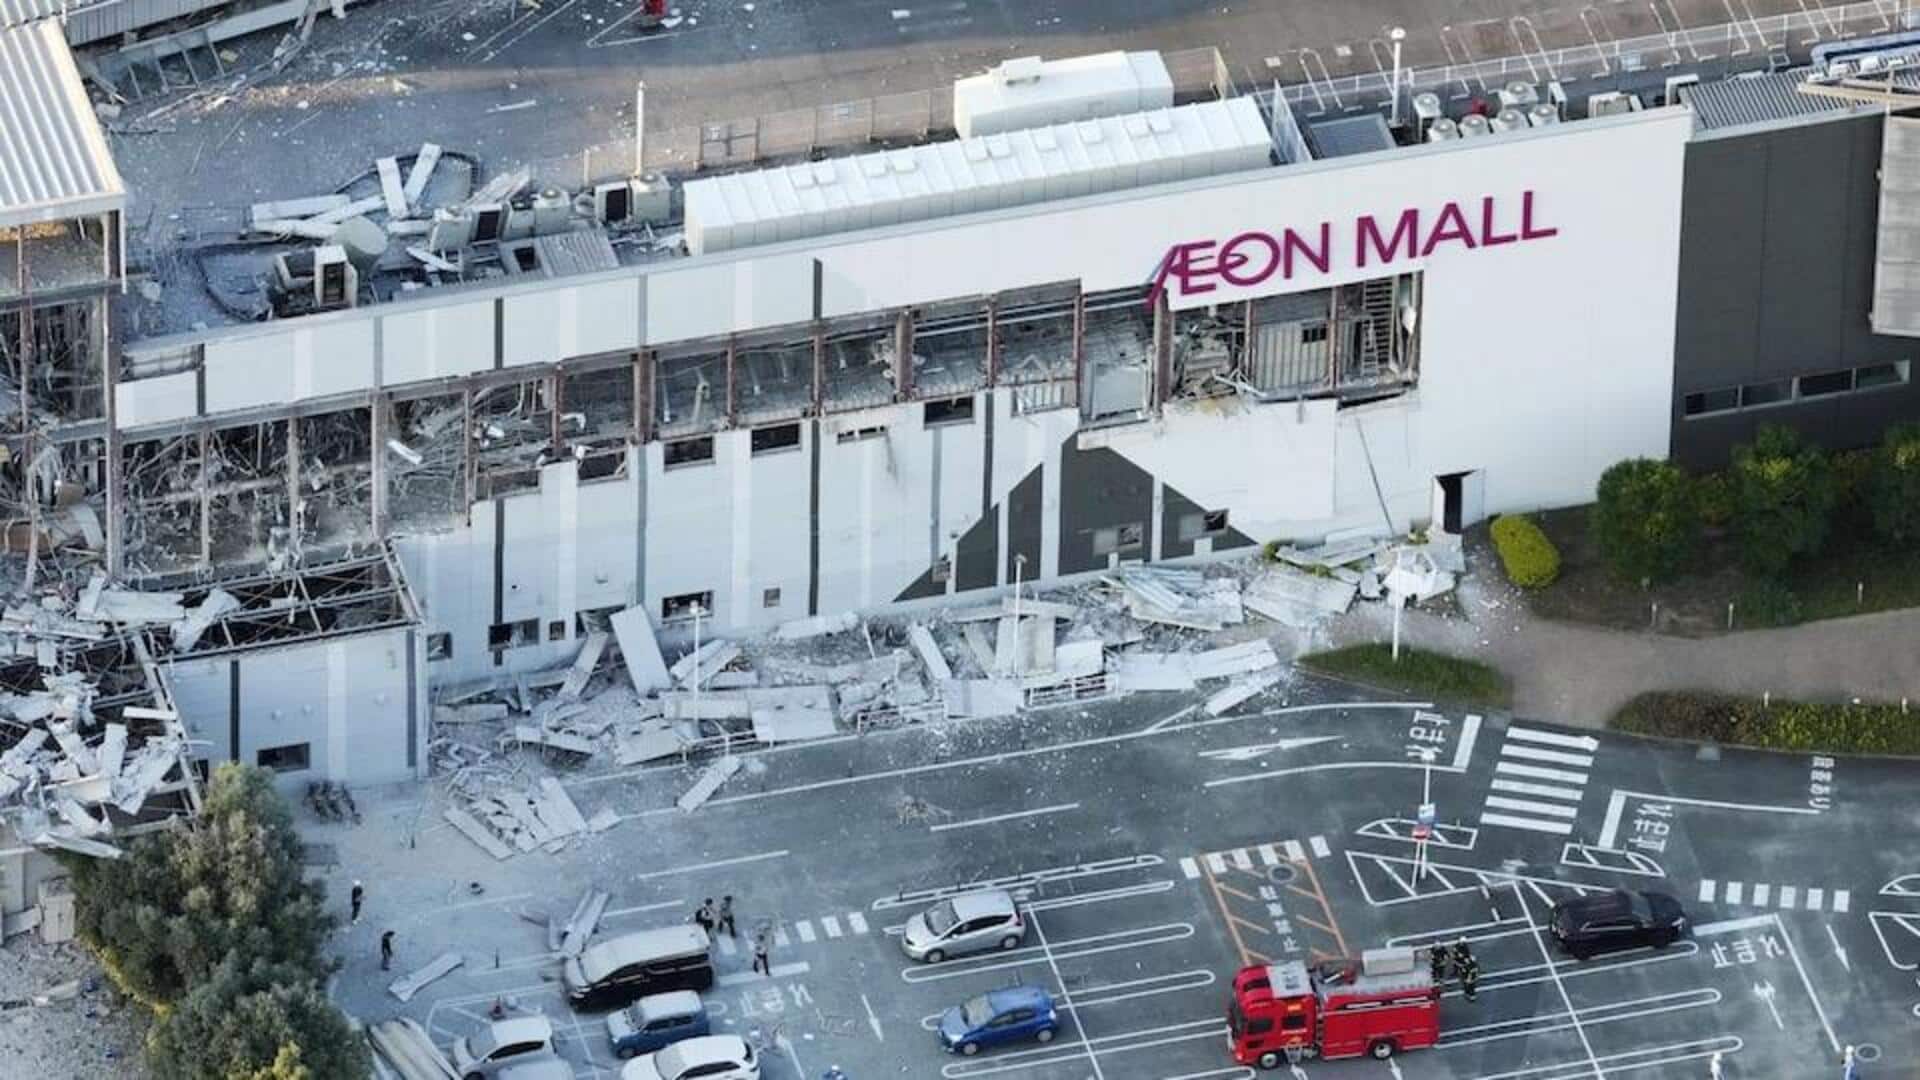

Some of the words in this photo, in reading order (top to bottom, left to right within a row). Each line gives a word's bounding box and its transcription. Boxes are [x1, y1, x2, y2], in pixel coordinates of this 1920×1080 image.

[1356, 191, 1558, 268] MALL
[1627, 803, 1673, 853] 止まれ
[1711, 934, 1785, 969] 止まれ
